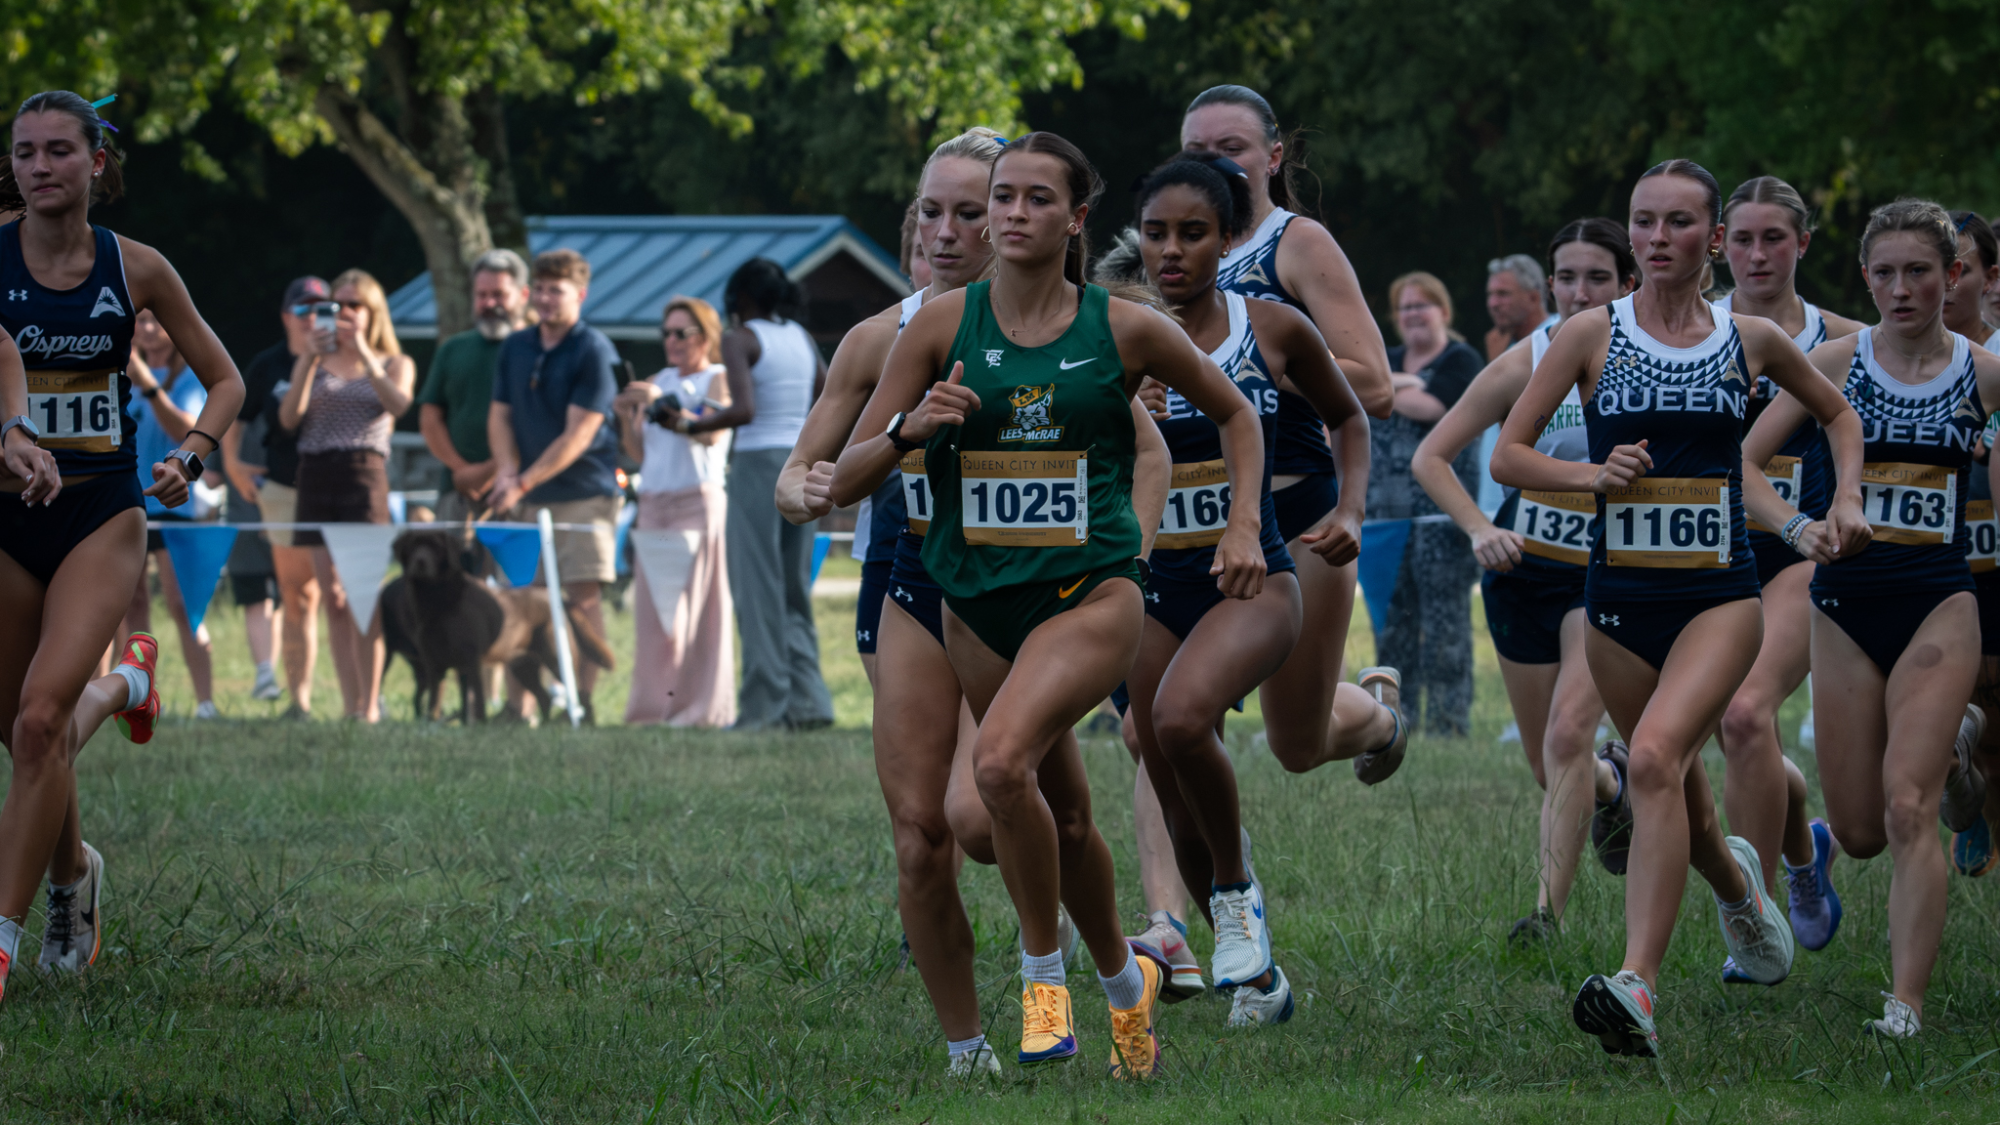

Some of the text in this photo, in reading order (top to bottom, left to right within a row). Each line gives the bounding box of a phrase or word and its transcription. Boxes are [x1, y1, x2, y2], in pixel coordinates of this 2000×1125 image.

[16, 325, 113, 360] Ospreys
[28, 376, 48, 387] EEN
[54, 376, 78, 387] CITY
[28, 394, 110, 434] 116
[1598, 386, 1748, 419] QUEENS
[1538, 404, 1586, 439] ARRE
[1863, 420, 1981, 453] UEEN
[901, 456, 925, 467] QUE
[963, 459, 1076, 471] QUEEN CITY INVIT
[1177, 466, 1227, 481] CITY INV
[1863, 469, 1887, 478] EEN
[1891, 470, 1917, 480] CITY
[971, 482, 1077, 523] 1025
[1658, 486, 1686, 496] CITY
[1690, 486, 1721, 496] INVIT
[1159, 487, 1232, 529] 16
[1616, 507, 1721, 547] 1166
